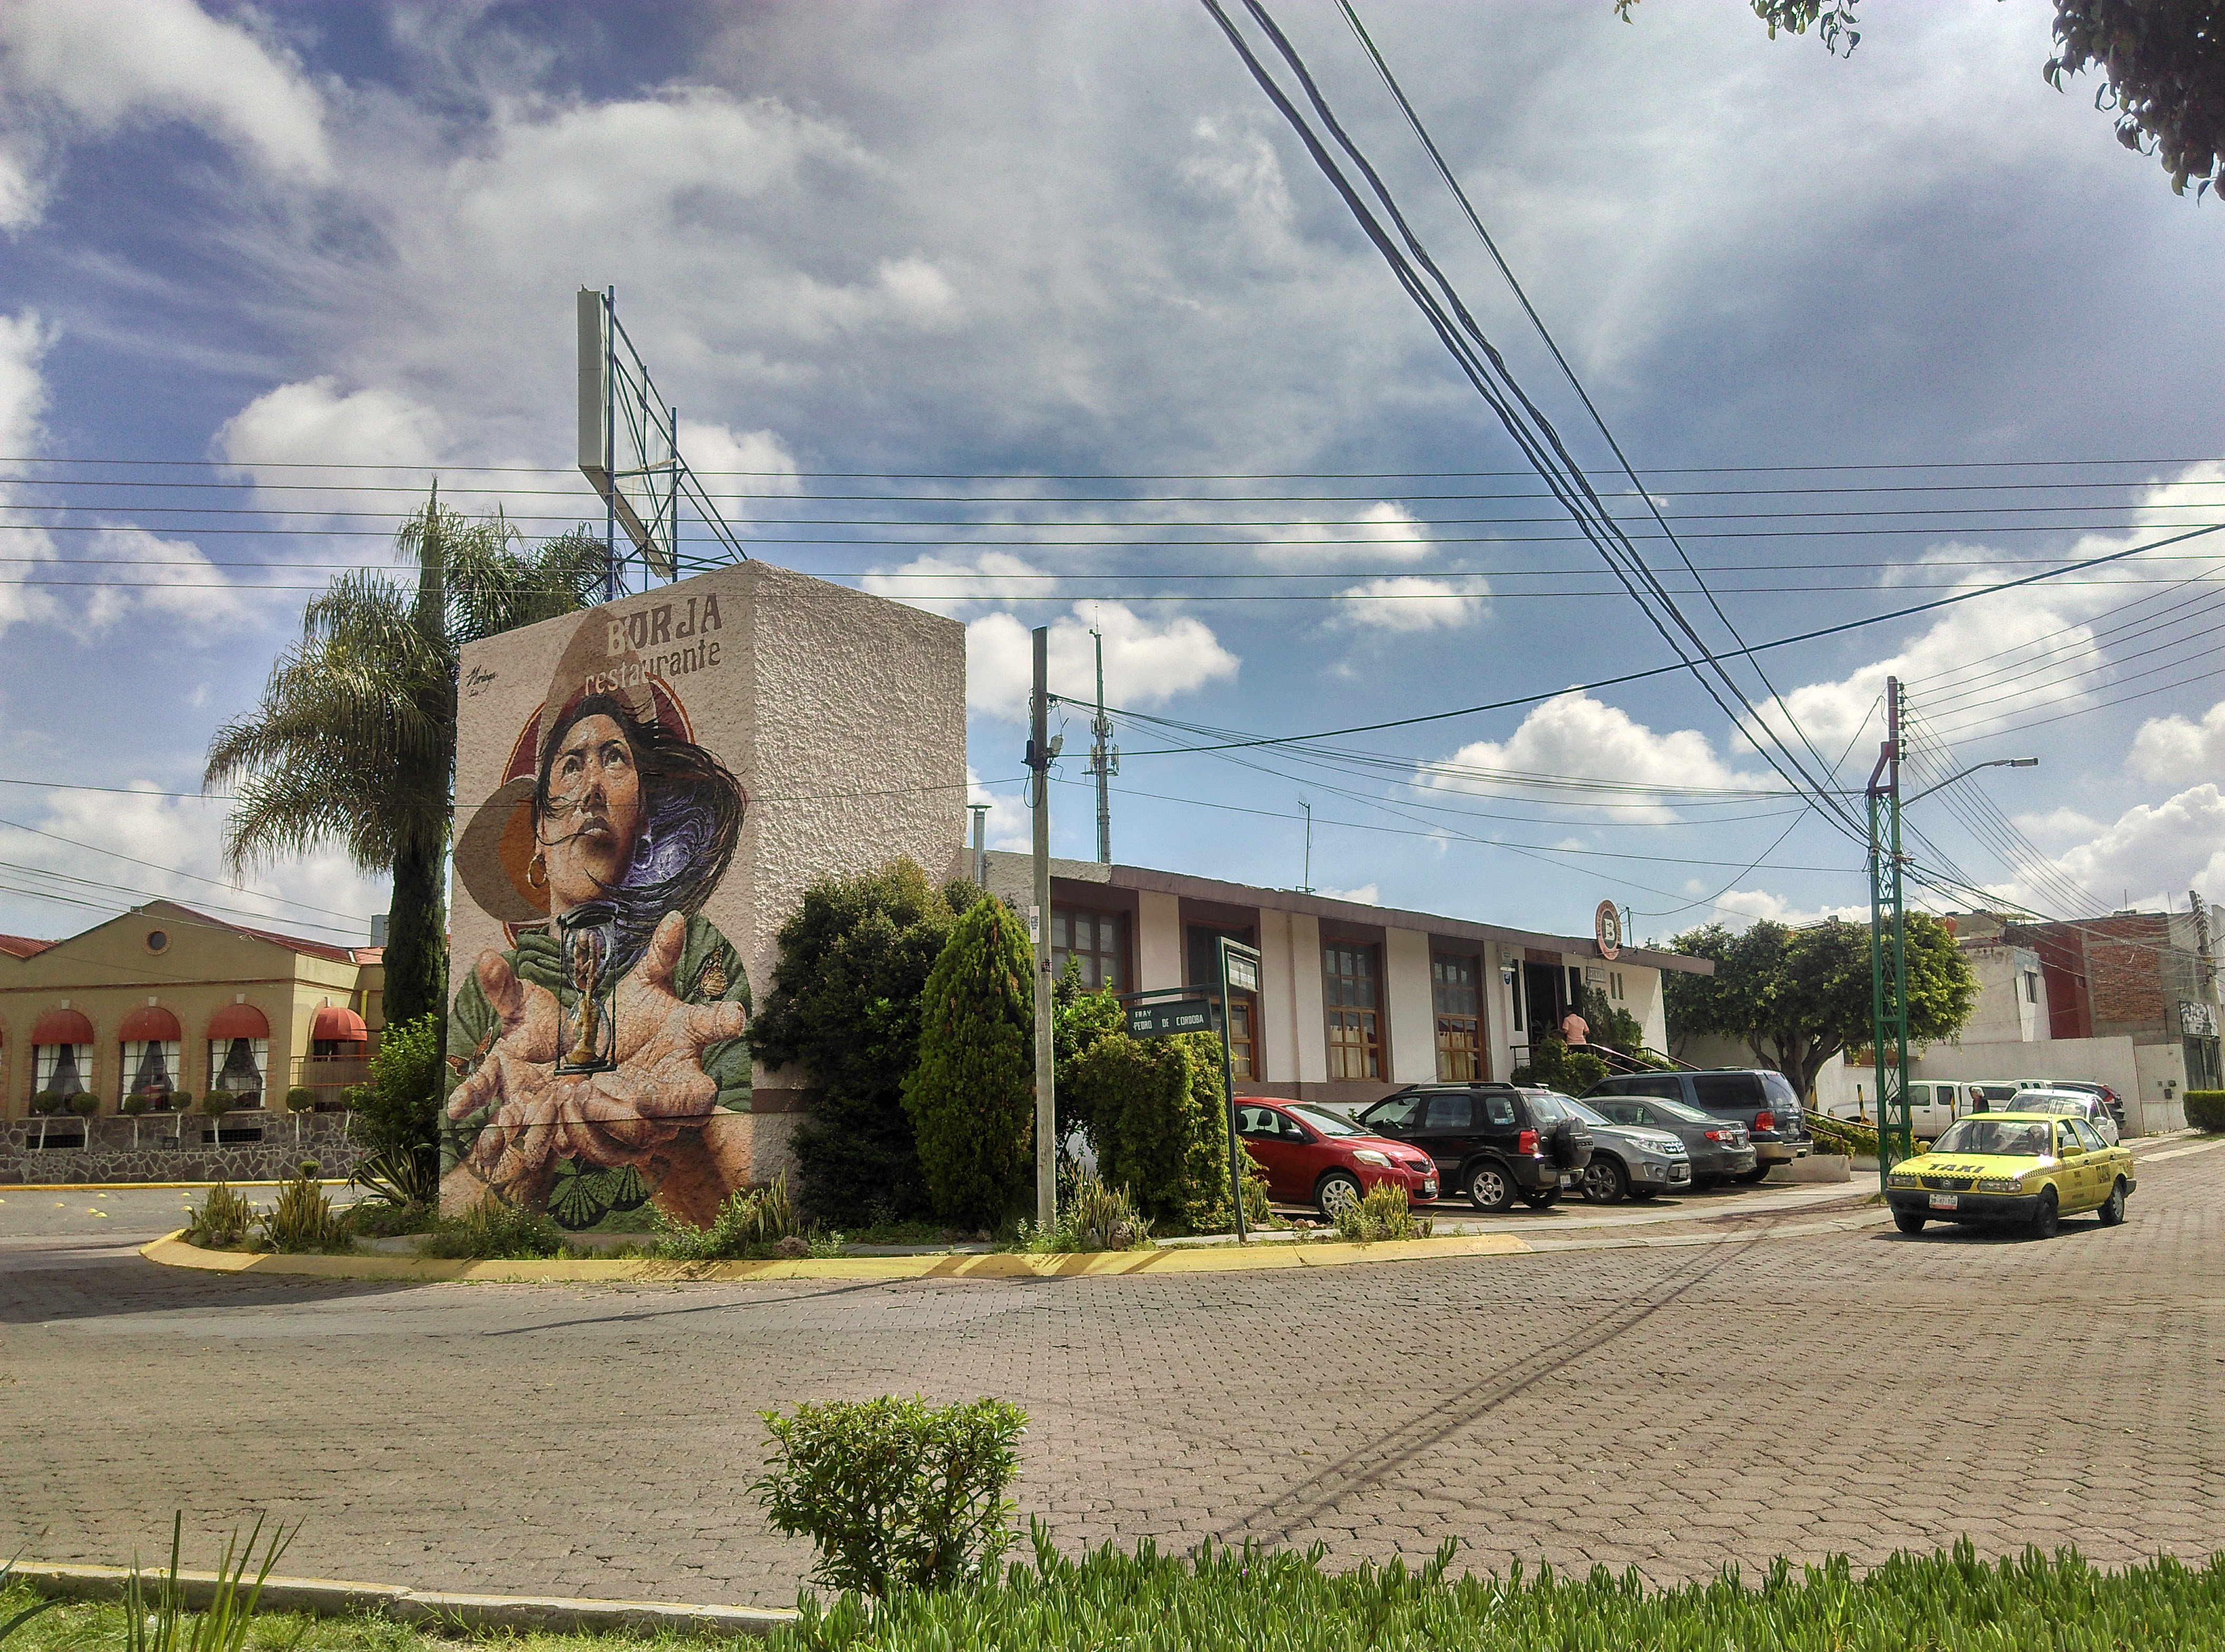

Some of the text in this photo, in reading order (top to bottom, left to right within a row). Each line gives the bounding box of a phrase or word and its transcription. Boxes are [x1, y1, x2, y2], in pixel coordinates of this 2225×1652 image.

[607, 593, 722, 656] BORJA
[585, 640, 721, 696] restaurante
[1133, 1014, 1204, 1031] PEDRO DE CORDOBA
[1928, 1163, 1985, 1173] TAXI
